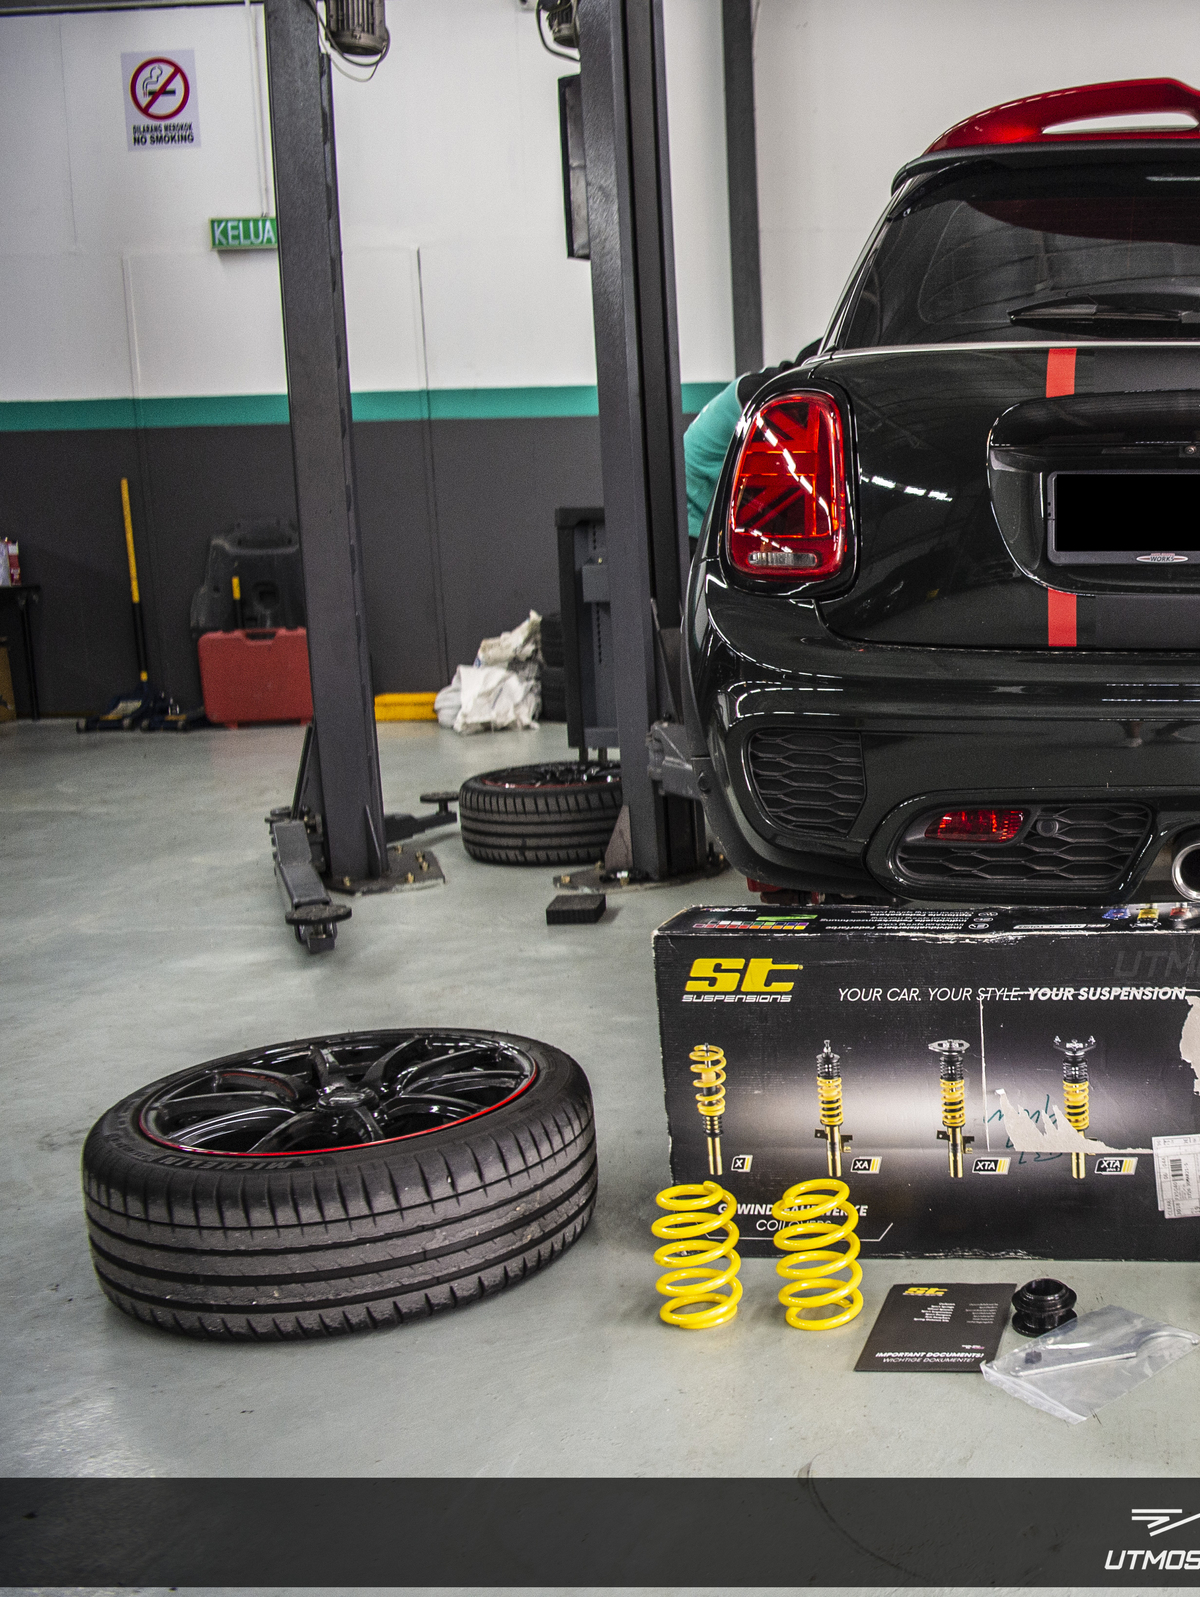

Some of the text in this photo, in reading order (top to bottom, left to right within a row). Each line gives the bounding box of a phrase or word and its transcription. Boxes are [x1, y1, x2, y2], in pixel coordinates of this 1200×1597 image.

[132, 132, 195, 146] NO SMOKING
[213, 220, 276, 245] KELUA
[838, 988, 882, 1001] YOUR
[886, 988, 922, 1001] CAR.
[928, 988, 973, 1001] YOUR
[975, 987, 1022, 1001] STYLE.
[1028, 987, 1075, 1000] YOUR
[158, 1156, 292, 1170] MICHELIN
[734, 1158, 743, 1168] X
[854, 1160, 869, 1169] XA
[975, 1162, 996, 1170] XTA
[1101, 1160, 1120, 1168] XTA
